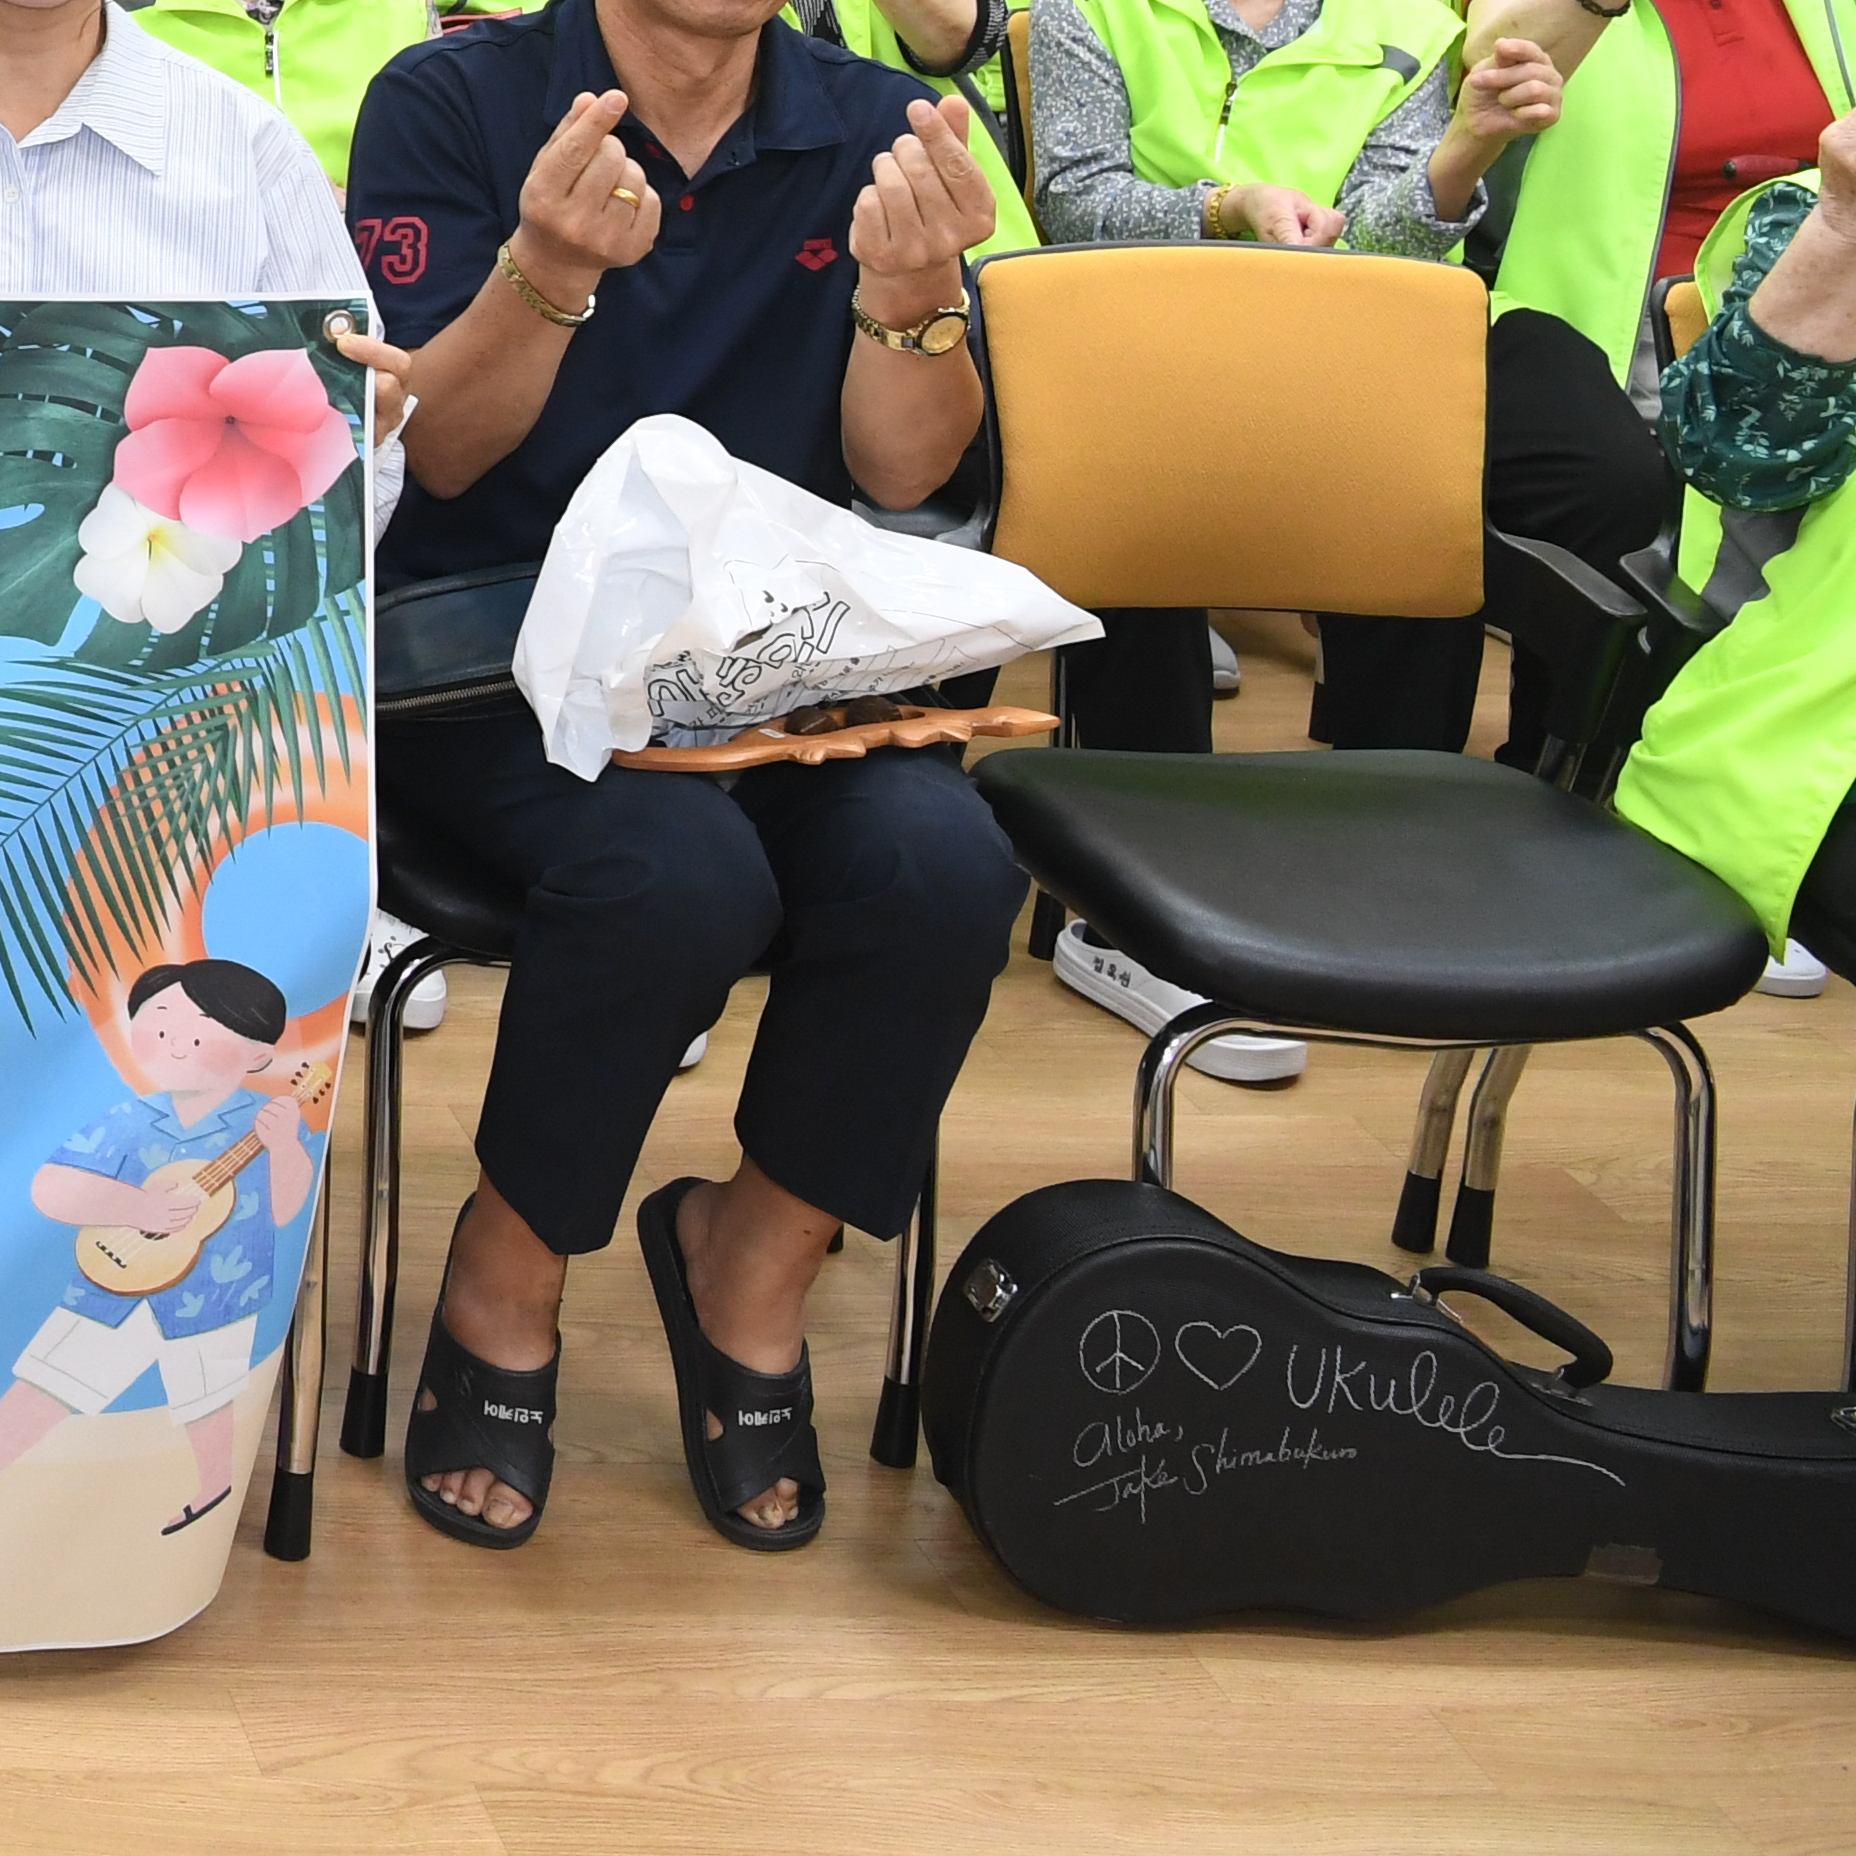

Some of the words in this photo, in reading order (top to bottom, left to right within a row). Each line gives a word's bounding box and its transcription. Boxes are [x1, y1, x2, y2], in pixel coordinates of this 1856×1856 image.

[354, 216, 429, 285] 73
[483, 1399, 544, 1425] 노인케어
[738, 1406, 793, 1428] 노인케어
